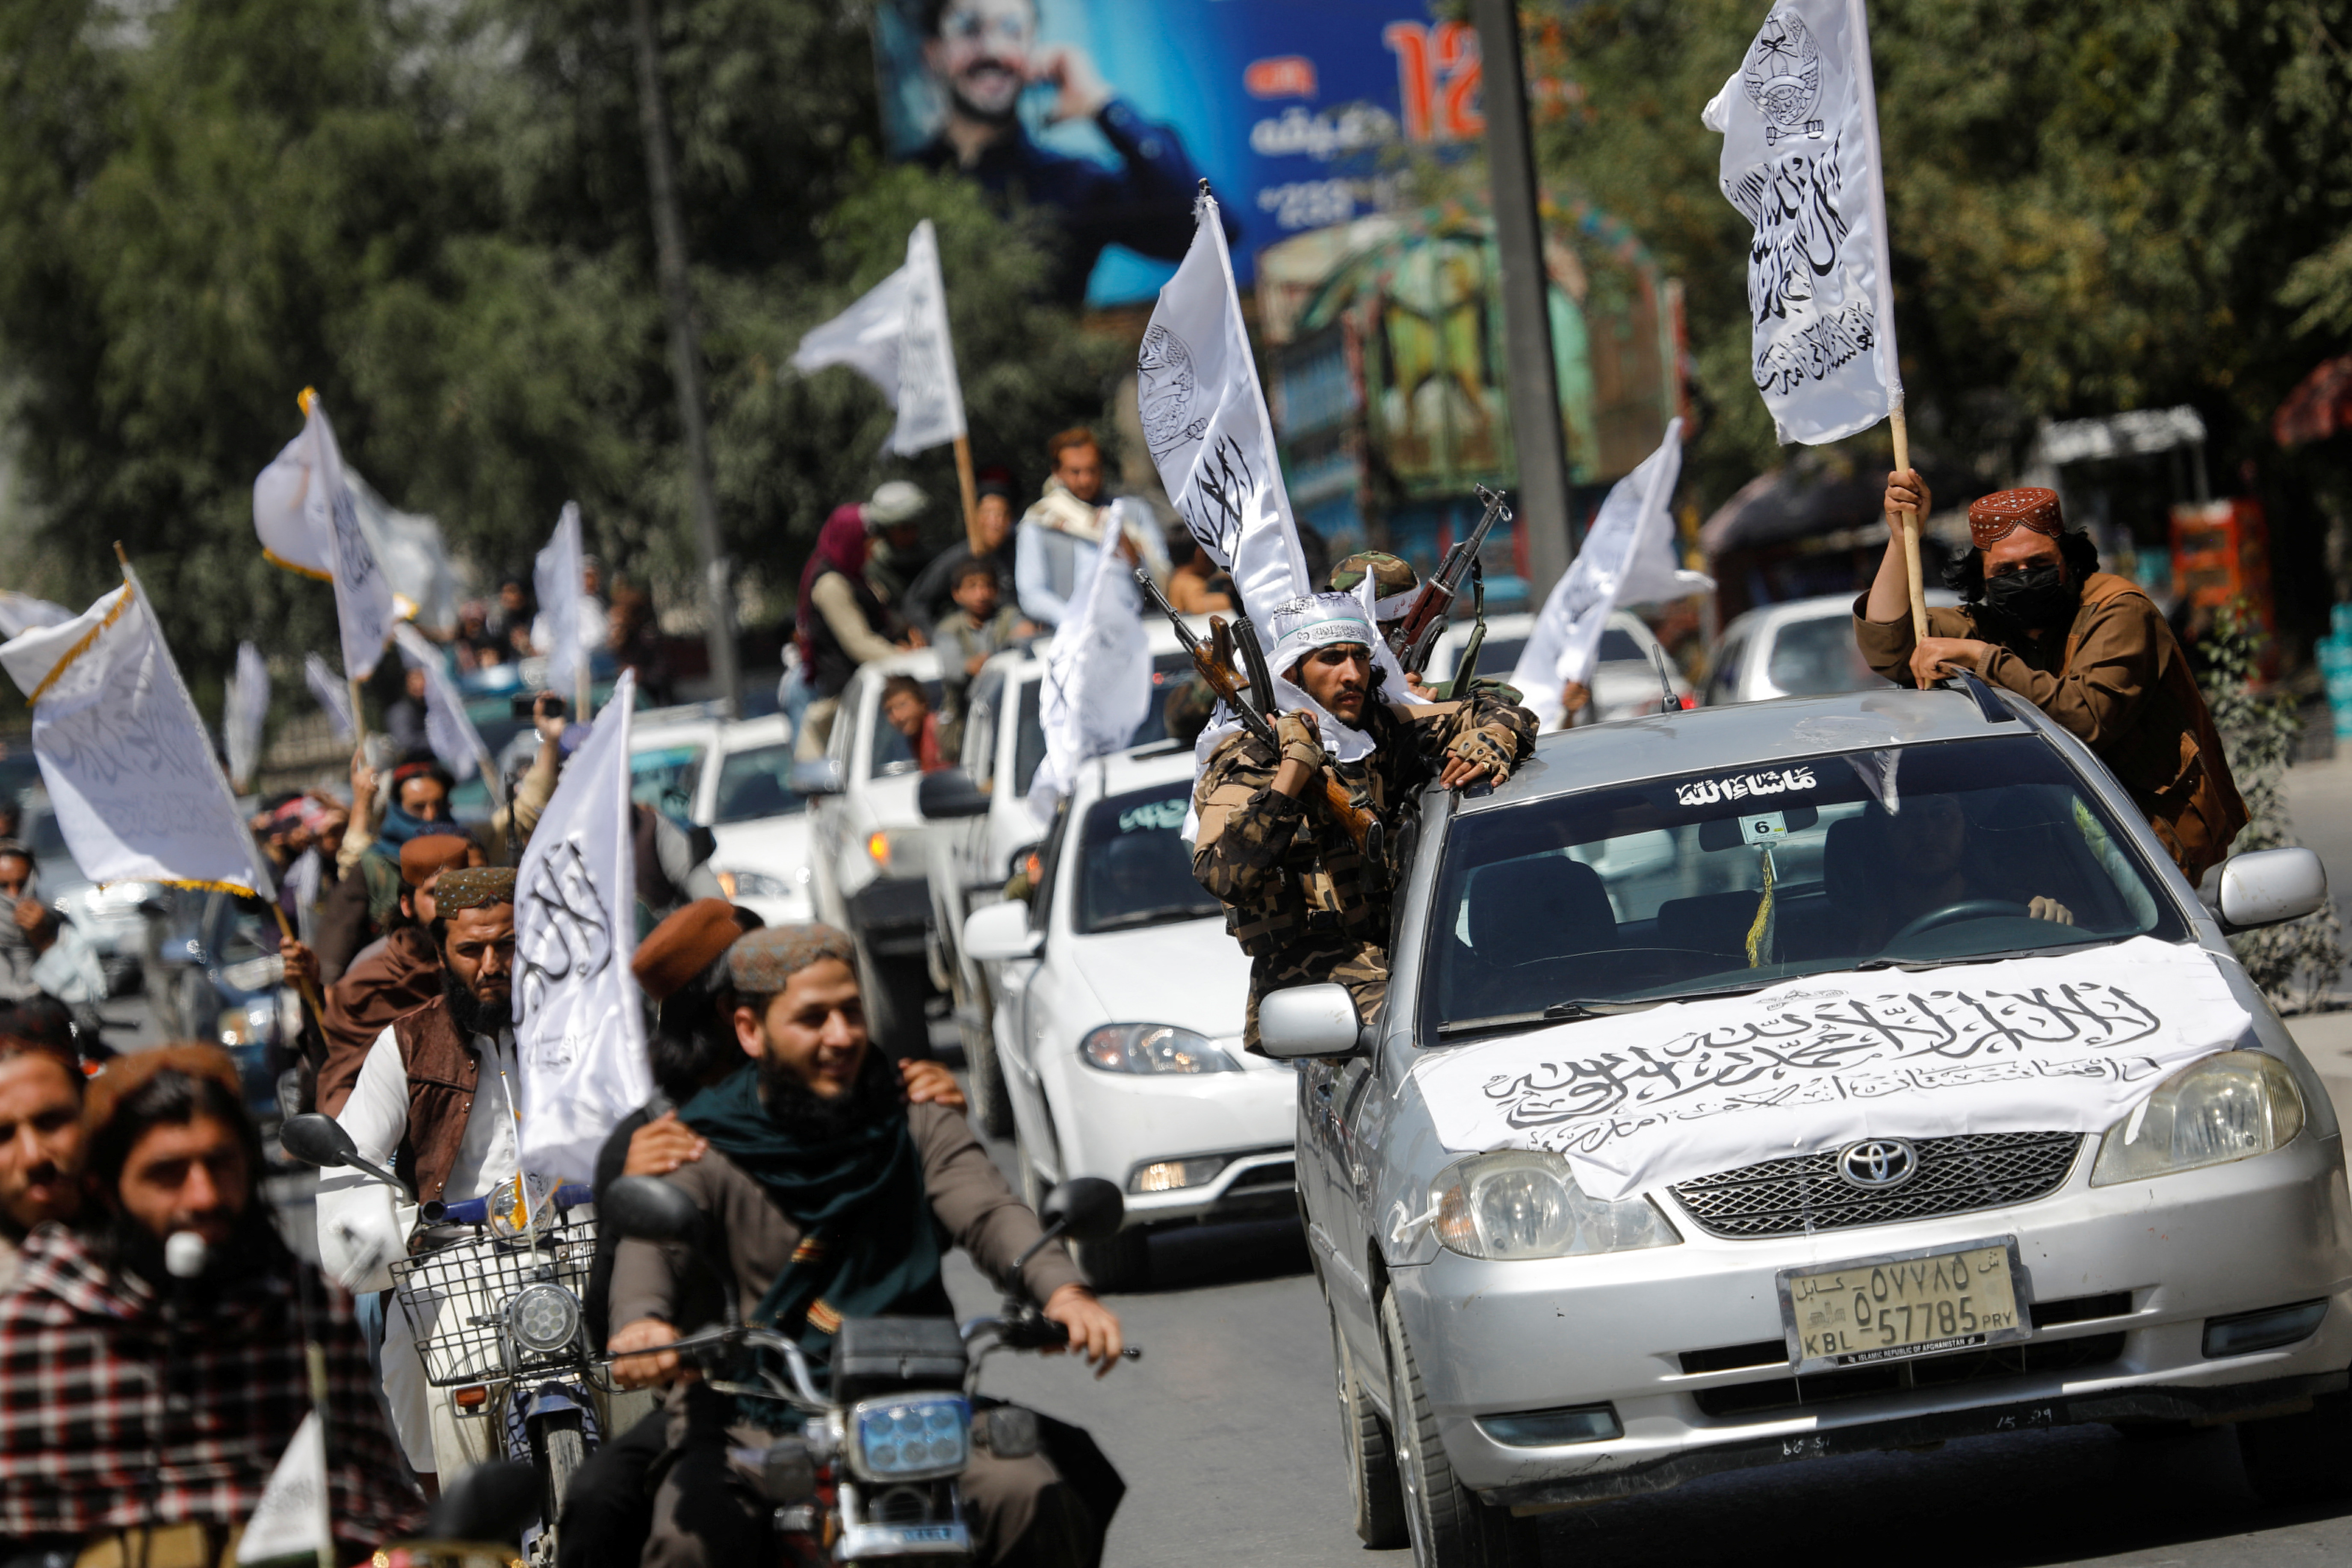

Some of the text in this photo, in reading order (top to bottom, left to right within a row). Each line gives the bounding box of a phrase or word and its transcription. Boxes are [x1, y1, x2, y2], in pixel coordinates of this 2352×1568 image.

[1755, 821, 1770, 834] 6
[1805, 1296, 2011, 1355] KBL 57785 PRY
[1859, 1338, 1965, 1361] ISLAMIC REPUBLIC OF AFGHANISTAN
